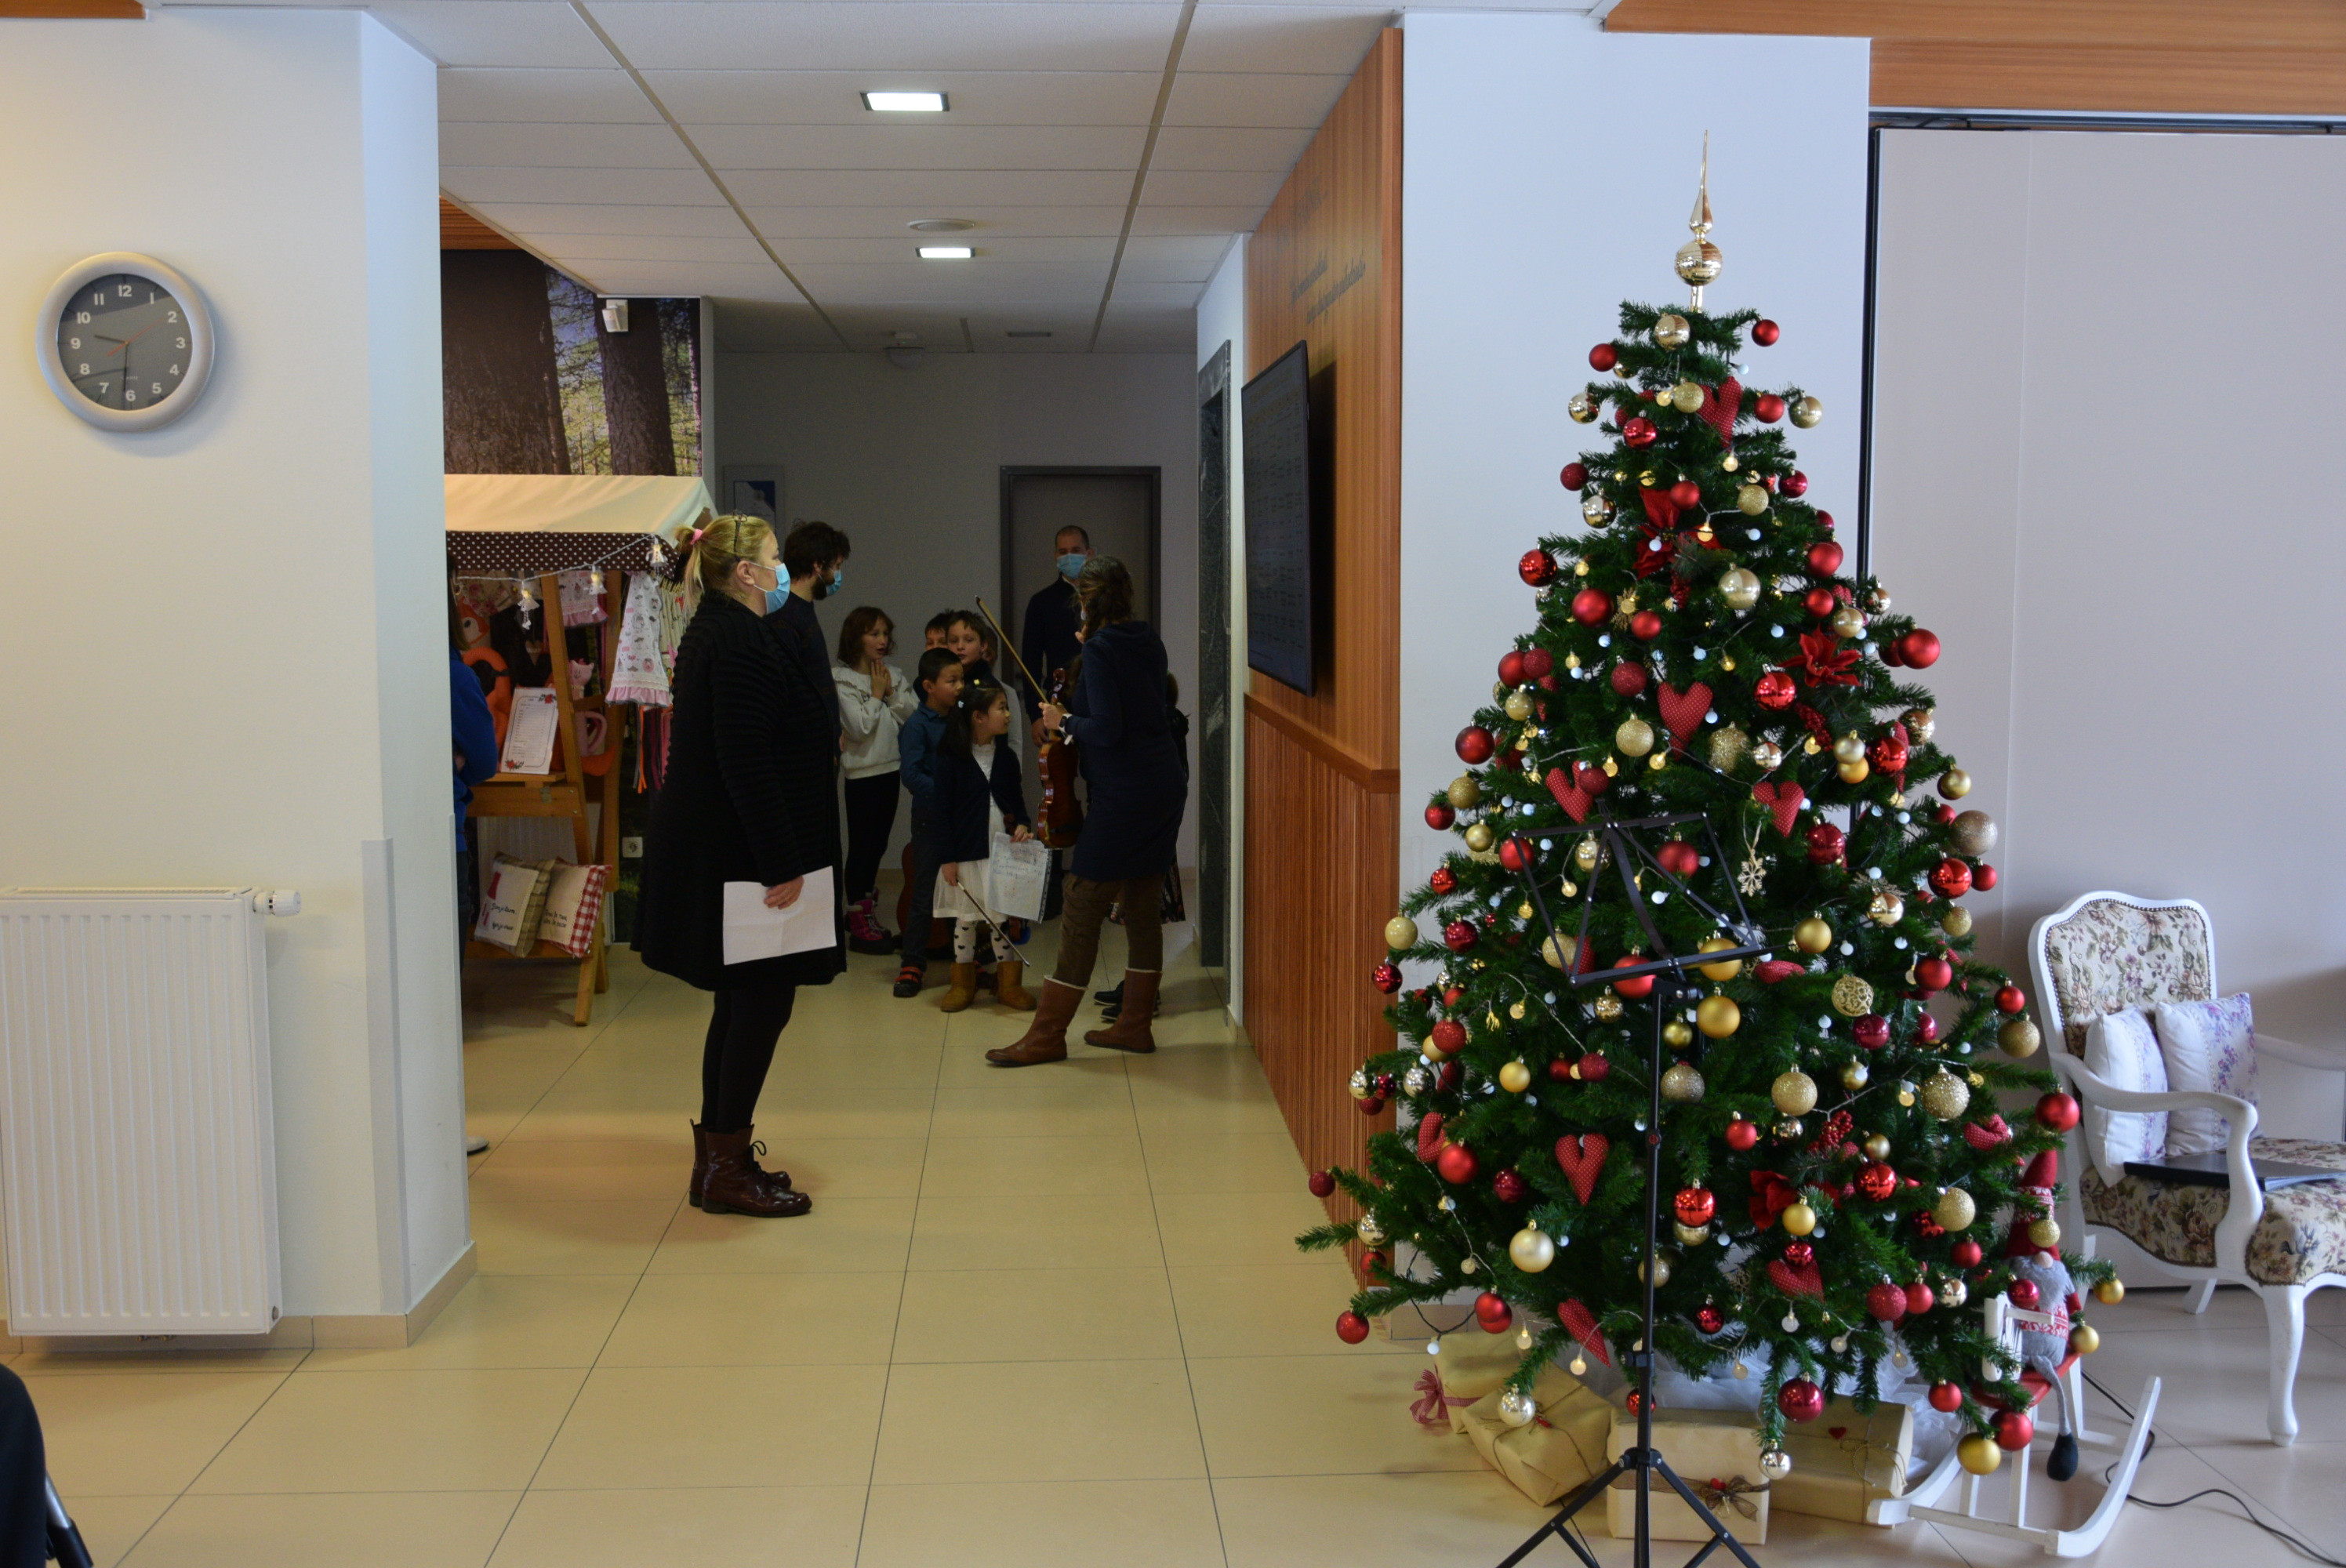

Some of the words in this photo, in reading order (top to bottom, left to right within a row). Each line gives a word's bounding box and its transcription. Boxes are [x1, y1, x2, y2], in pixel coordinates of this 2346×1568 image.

[118, 285, 132, 297] 12
[94, 293, 104, 305] 11
[150, 292, 154, 304] 1
[77, 312, 90, 324] 10
[168, 311, 177, 323] 2
[71, 337, 81, 349] 9
[176, 337, 186, 349] 3
[80, 363, 90, 375] 8
[169, 365, 180, 376] 4
[99, 383, 109, 394] 7
[152, 383, 162, 394] 5
[125, 390, 136, 401] 6
